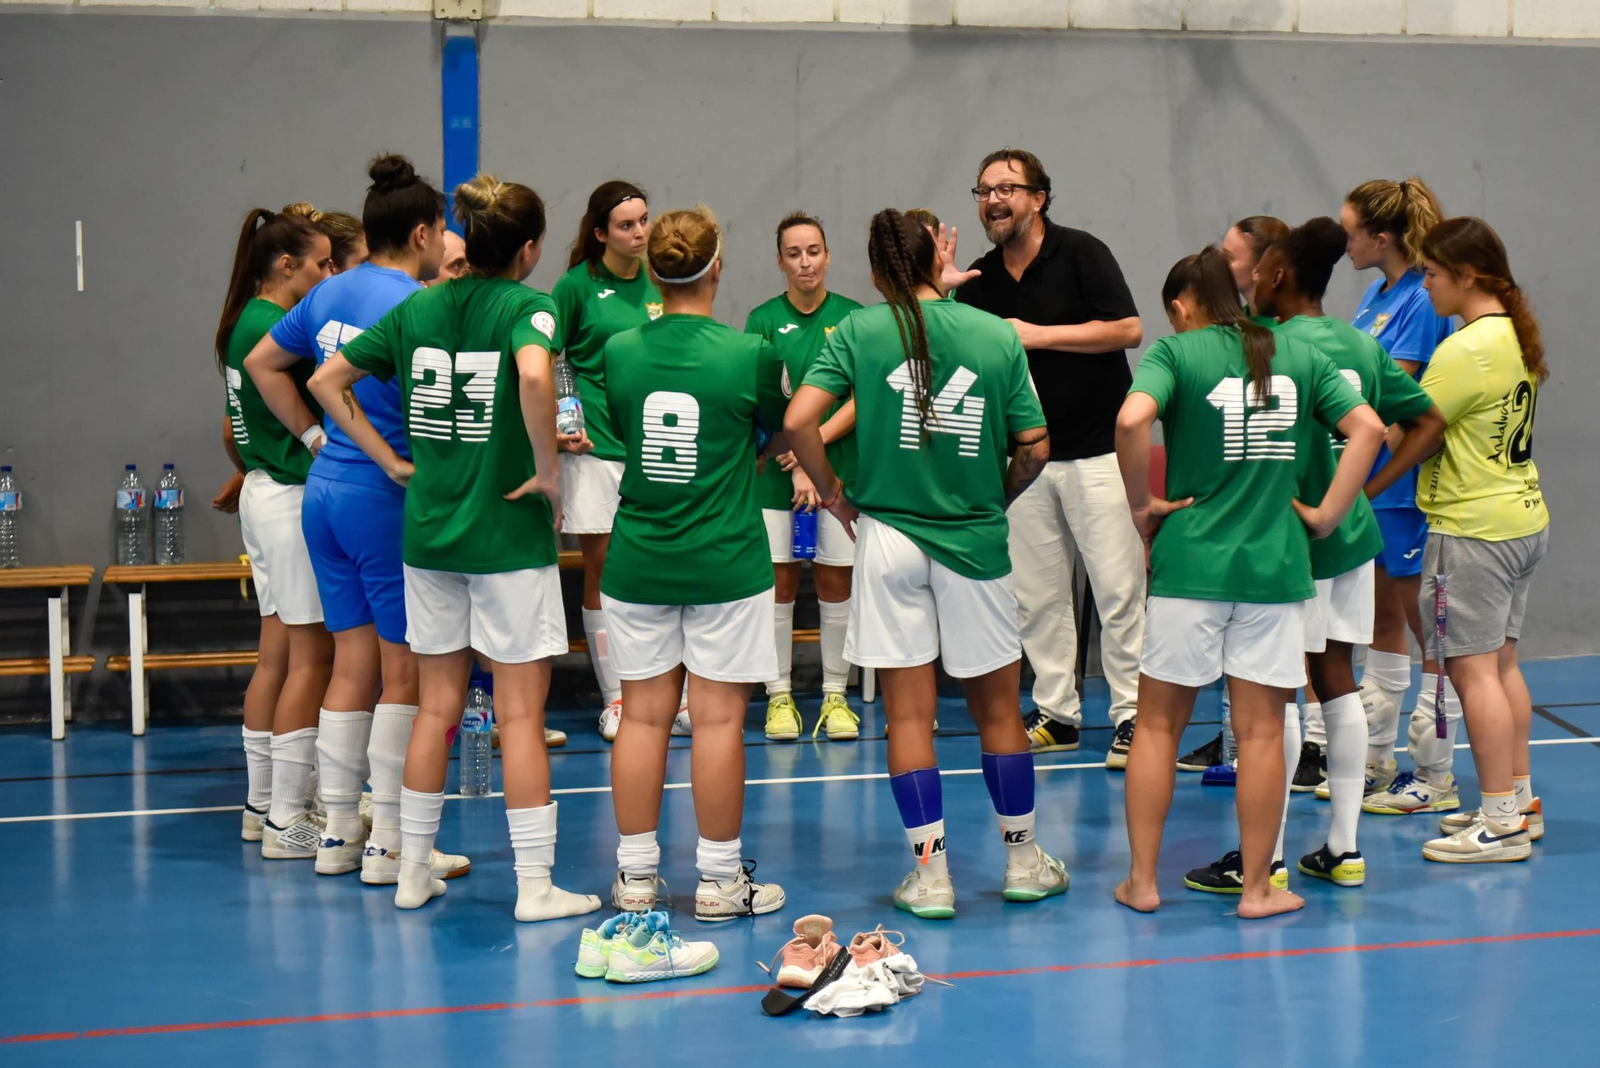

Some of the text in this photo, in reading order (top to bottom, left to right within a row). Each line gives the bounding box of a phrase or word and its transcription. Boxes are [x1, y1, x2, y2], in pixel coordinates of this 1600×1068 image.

[409, 347, 501, 442] 23
[641, 391, 699, 483] 8
[886, 358, 985, 456] 14
[1206, 375, 1297, 460] 12
[1430, 471, 1439, 492] UTE
[1004, 829, 1028, 843] KE
